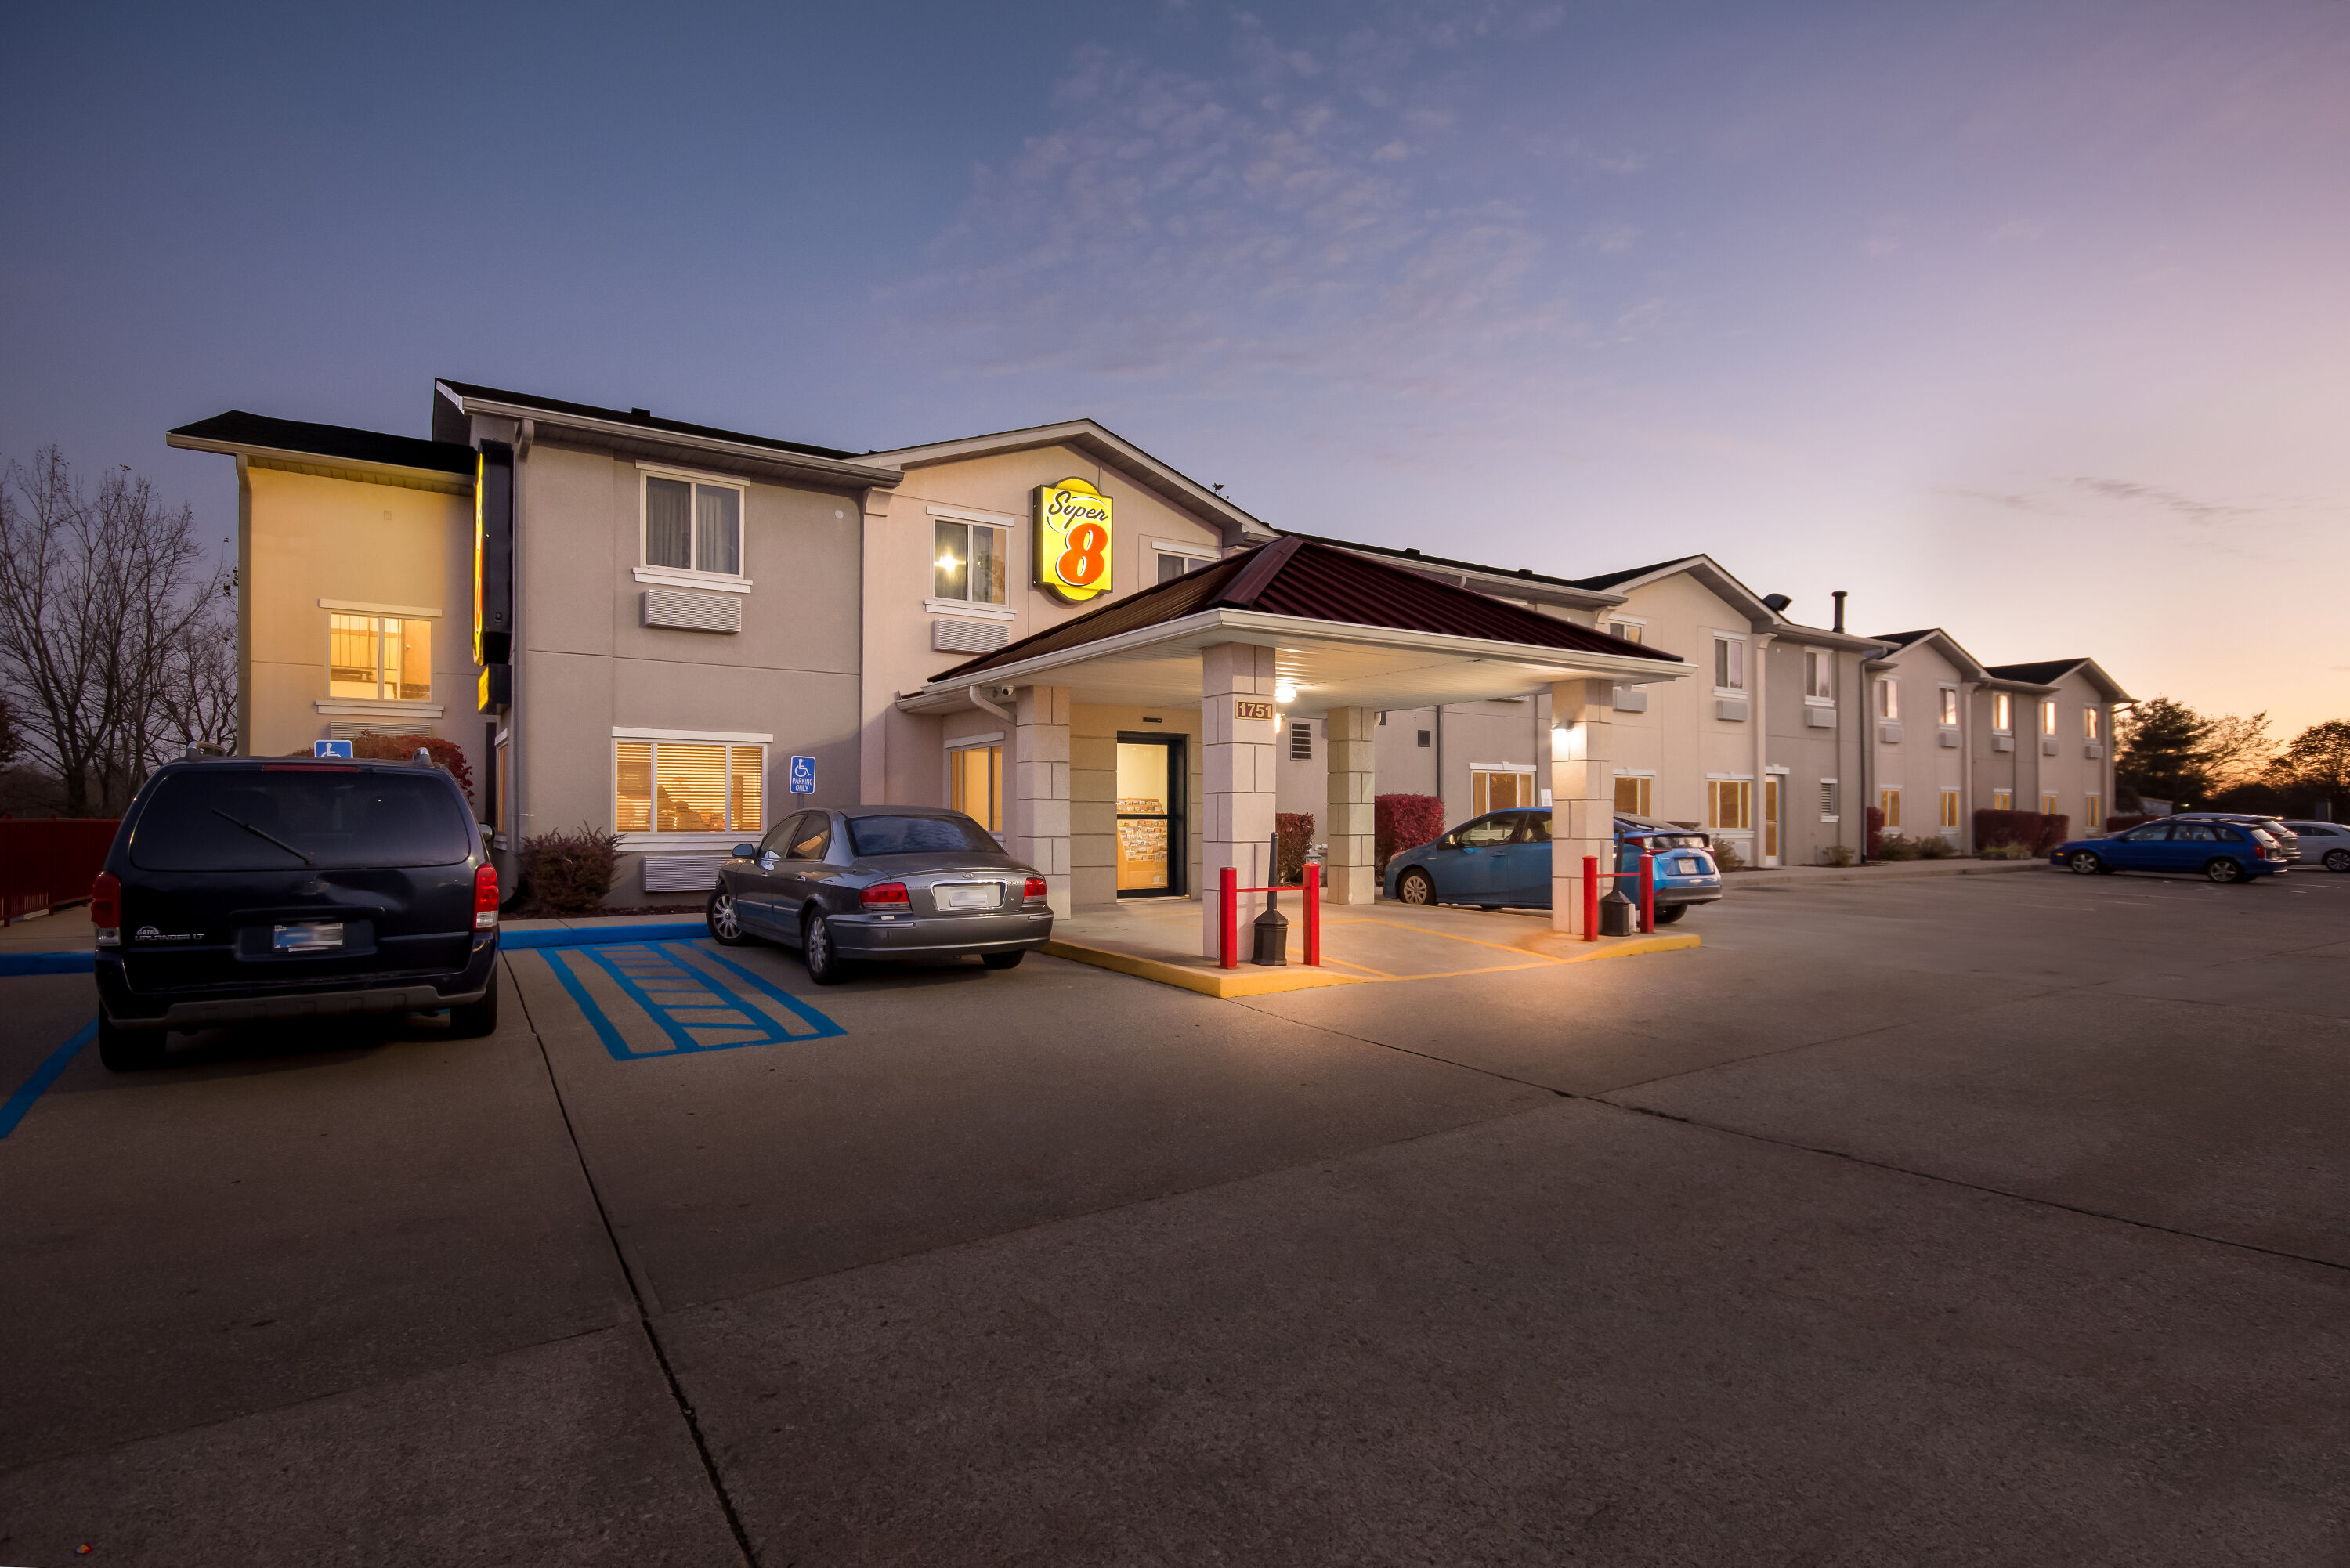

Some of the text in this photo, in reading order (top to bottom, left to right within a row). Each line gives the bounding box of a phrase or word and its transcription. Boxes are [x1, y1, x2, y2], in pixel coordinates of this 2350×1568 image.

[1047, 490, 1108, 529] Super
[1055, 522, 1108, 587] 8
[1239, 703, 1271, 718] 1751
[792, 777, 813, 786] PARKING
